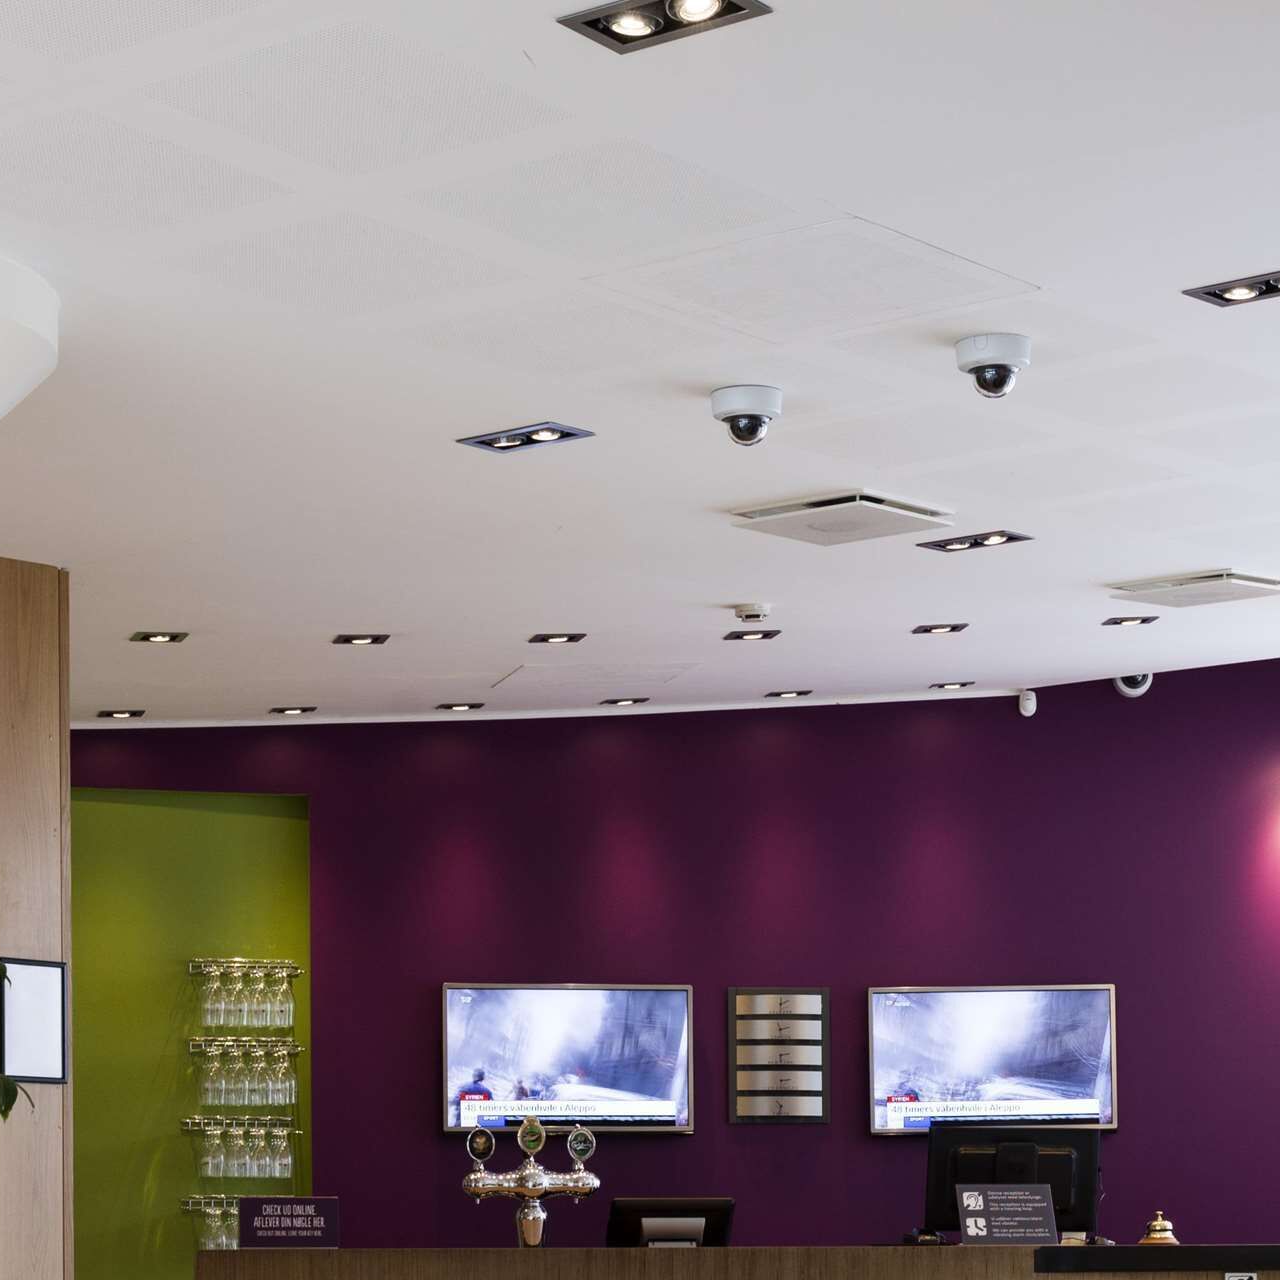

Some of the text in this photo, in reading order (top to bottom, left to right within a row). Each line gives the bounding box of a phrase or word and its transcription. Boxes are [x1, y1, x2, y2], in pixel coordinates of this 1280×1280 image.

[262, 1204, 281, 1216] CHECK
[253, 1216, 280, 1228] AFLEVER
[280, 1216, 292, 1228] DIN
